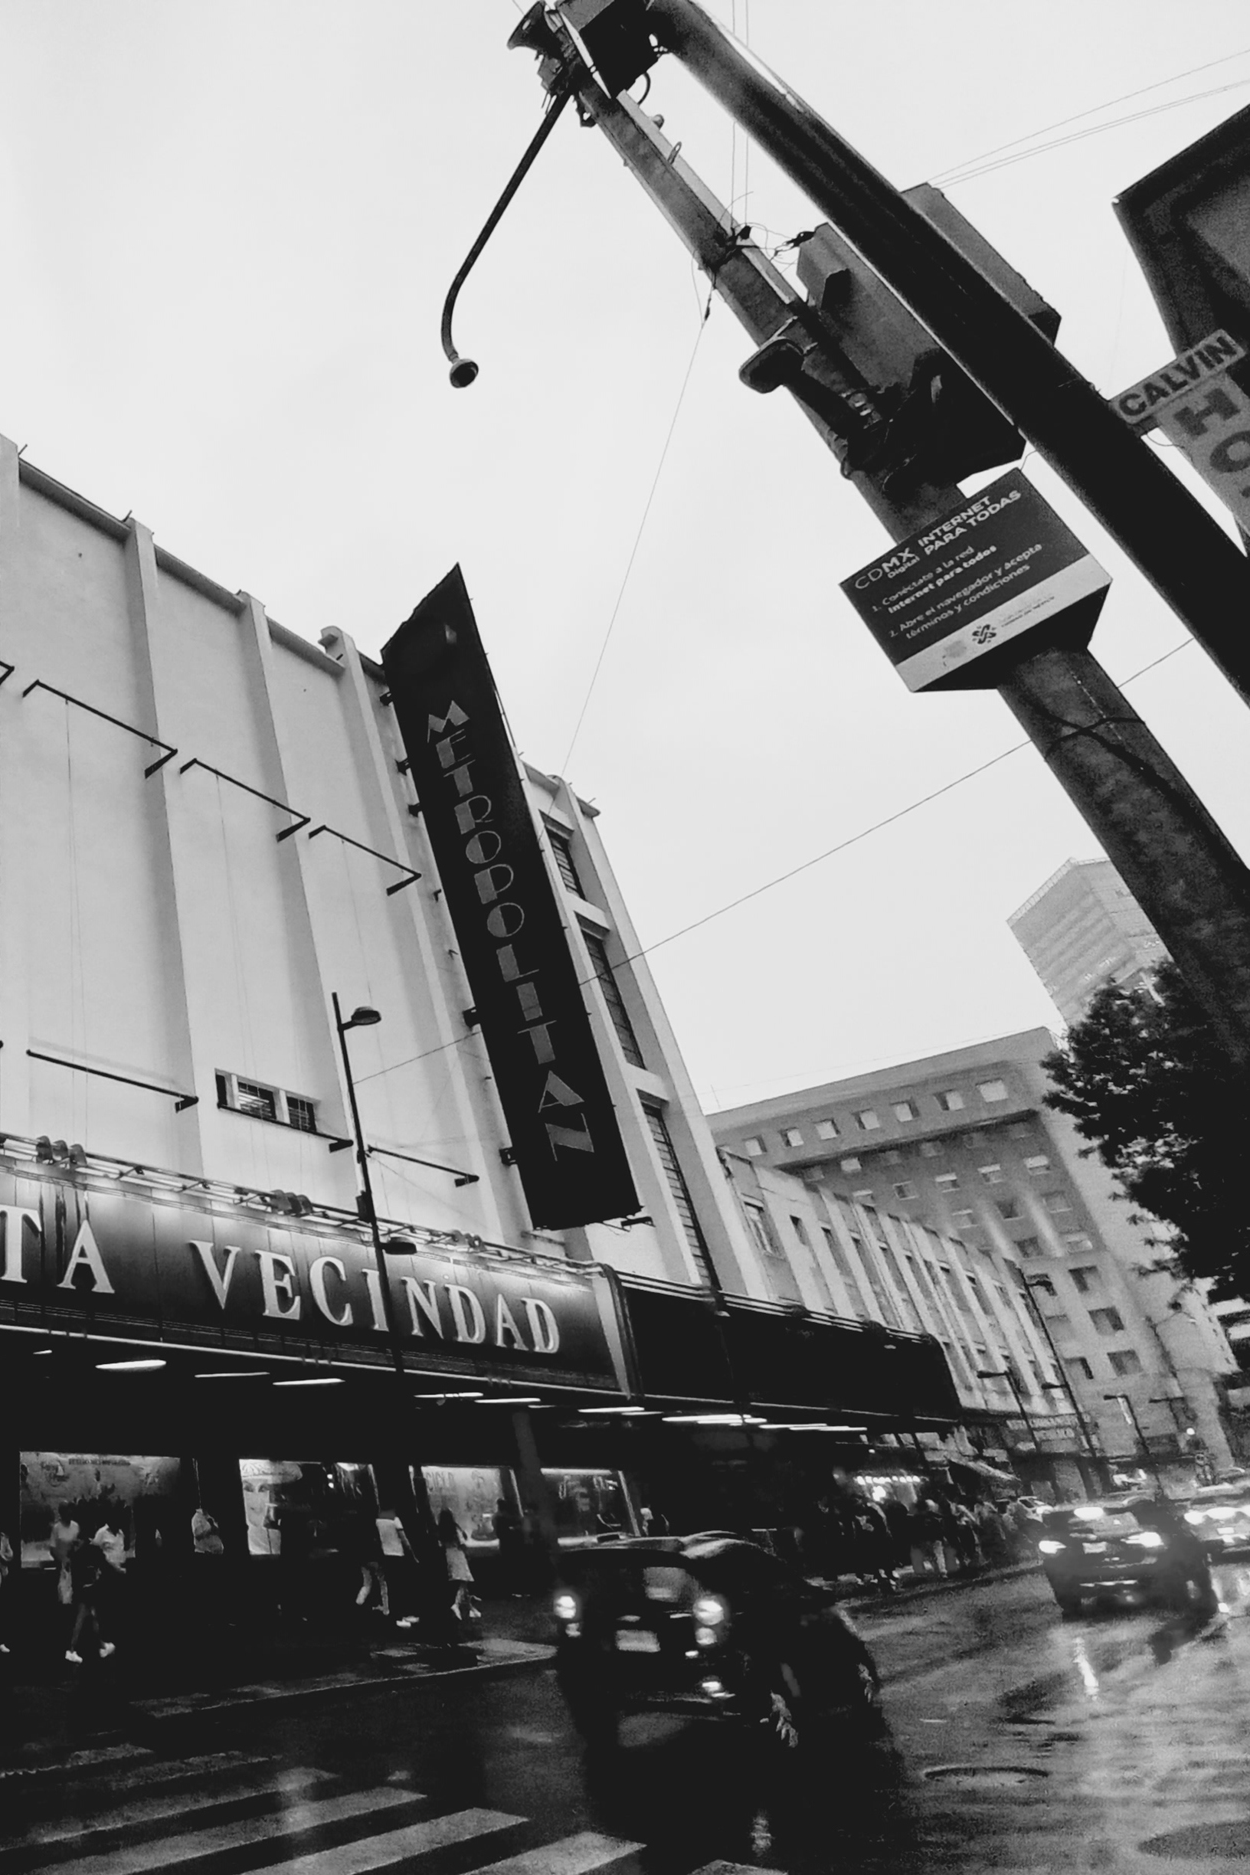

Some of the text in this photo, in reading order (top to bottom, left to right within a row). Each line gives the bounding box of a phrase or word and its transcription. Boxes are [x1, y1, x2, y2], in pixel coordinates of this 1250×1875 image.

[1119, 336, 1237, 416] CALVIN
[1173, 387, 1250, 499] HO
[918, 496, 990, 547] INTERNET
[924, 490, 1021, 555] PARA TODAS
[855, 548, 915, 589] CDMX
[887, 555, 920, 579] Digital
[888, 545, 997, 614] Internet para todos
[900, 613, 924, 631] Abre
[937, 573, 993, 610] navegador
[994, 567, 1002, 577] y
[1004, 544, 1042, 570] acepta
[942, 559, 954, 568] la
[955, 546, 975, 561] red
[955, 603, 962, 613] y
[963, 564, 1031, 606] condiciones
[427, 700, 594, 1161] METROPOLITAN
[189, 1240, 560, 1354] VECINDAD
